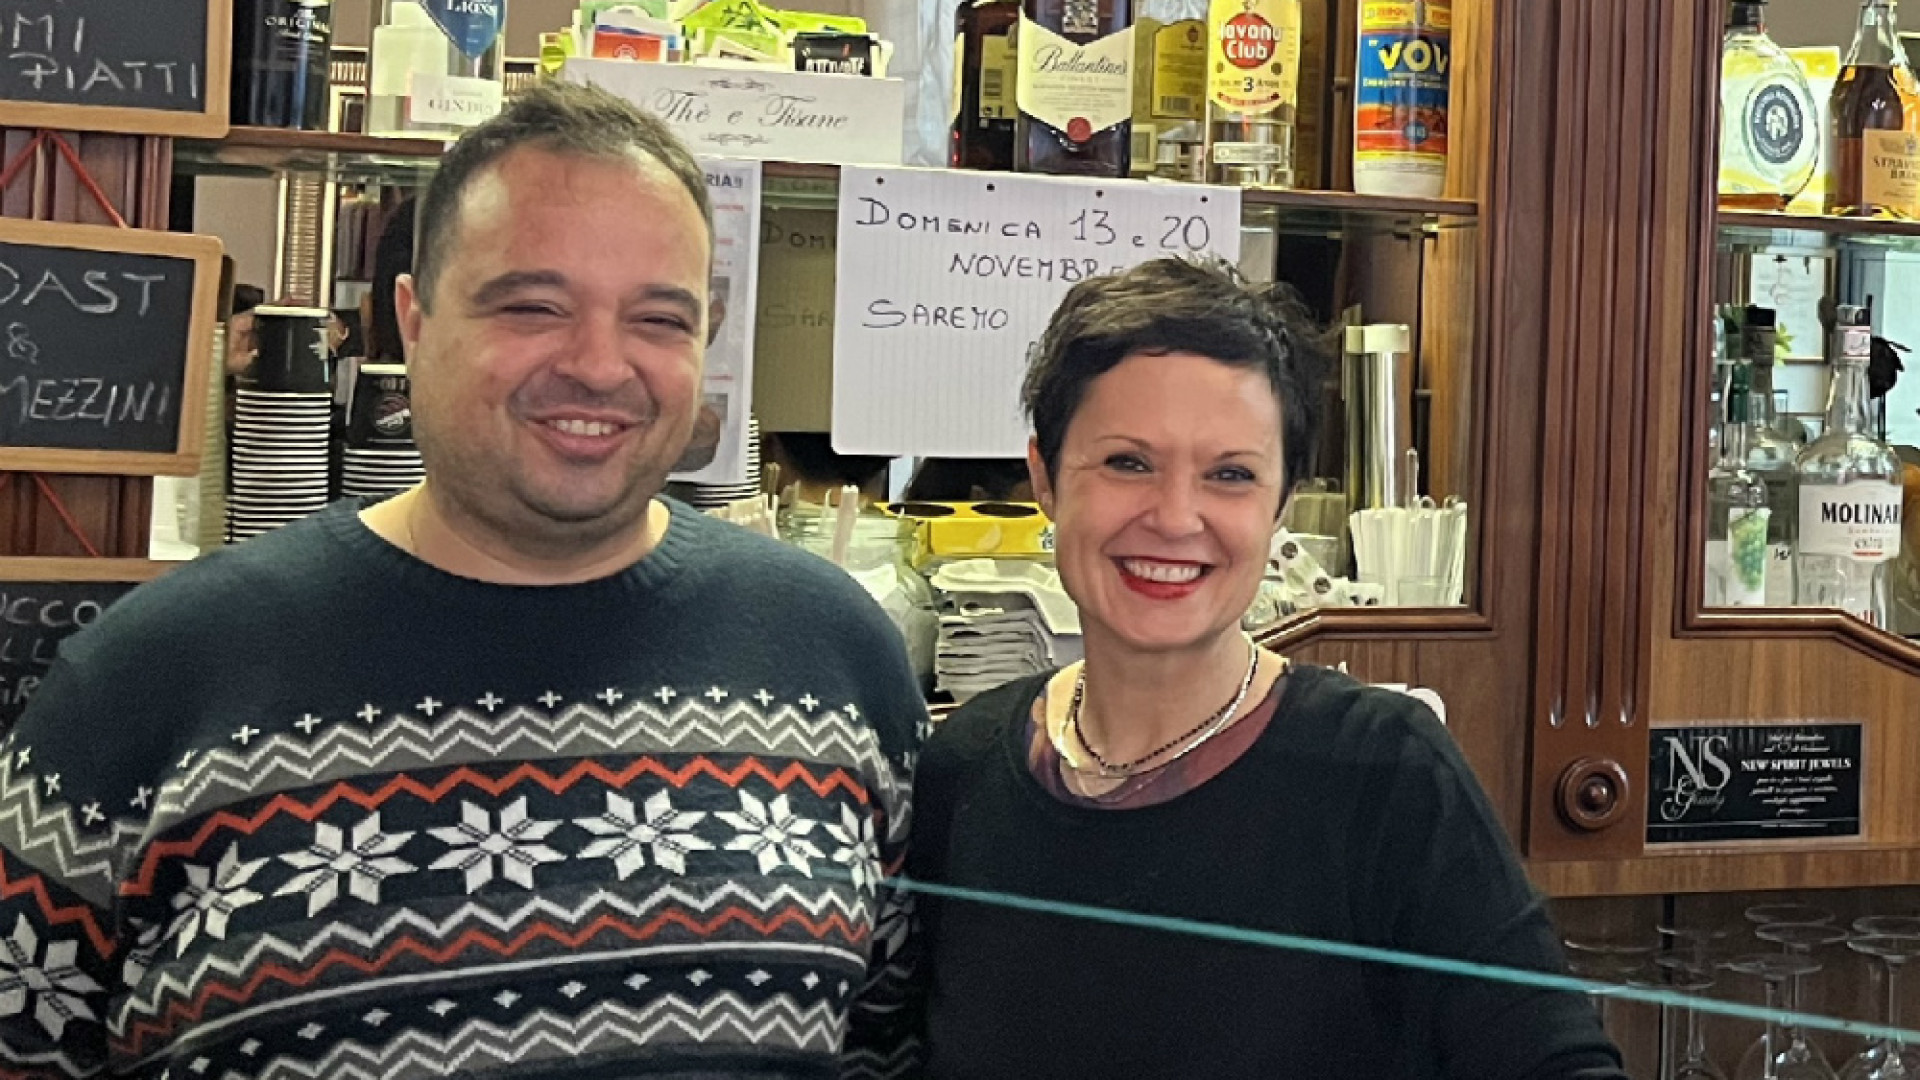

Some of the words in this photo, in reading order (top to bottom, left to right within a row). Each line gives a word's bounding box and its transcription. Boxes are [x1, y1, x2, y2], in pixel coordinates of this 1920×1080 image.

[0, 13, 85, 53] MI
[1226, 40, 1268, 60] Club
[8, 52, 198, 98] PIATTI
[1243, 76, 1254, 93] 3
[652, 88, 709, 124] Thè
[727, 110, 743, 125] e
[758, 93, 849, 128] Tisane
[856, 197, 1041, 239] DOMENICA
[1069, 208, 1117, 246] 13
[1132, 234, 1145, 247] e
[1159, 214, 1210, 252] 20
[861, 299, 1009, 331] SAREMO
[8, 322, 39, 365] &
[1740, 759, 1769, 772] NEW
